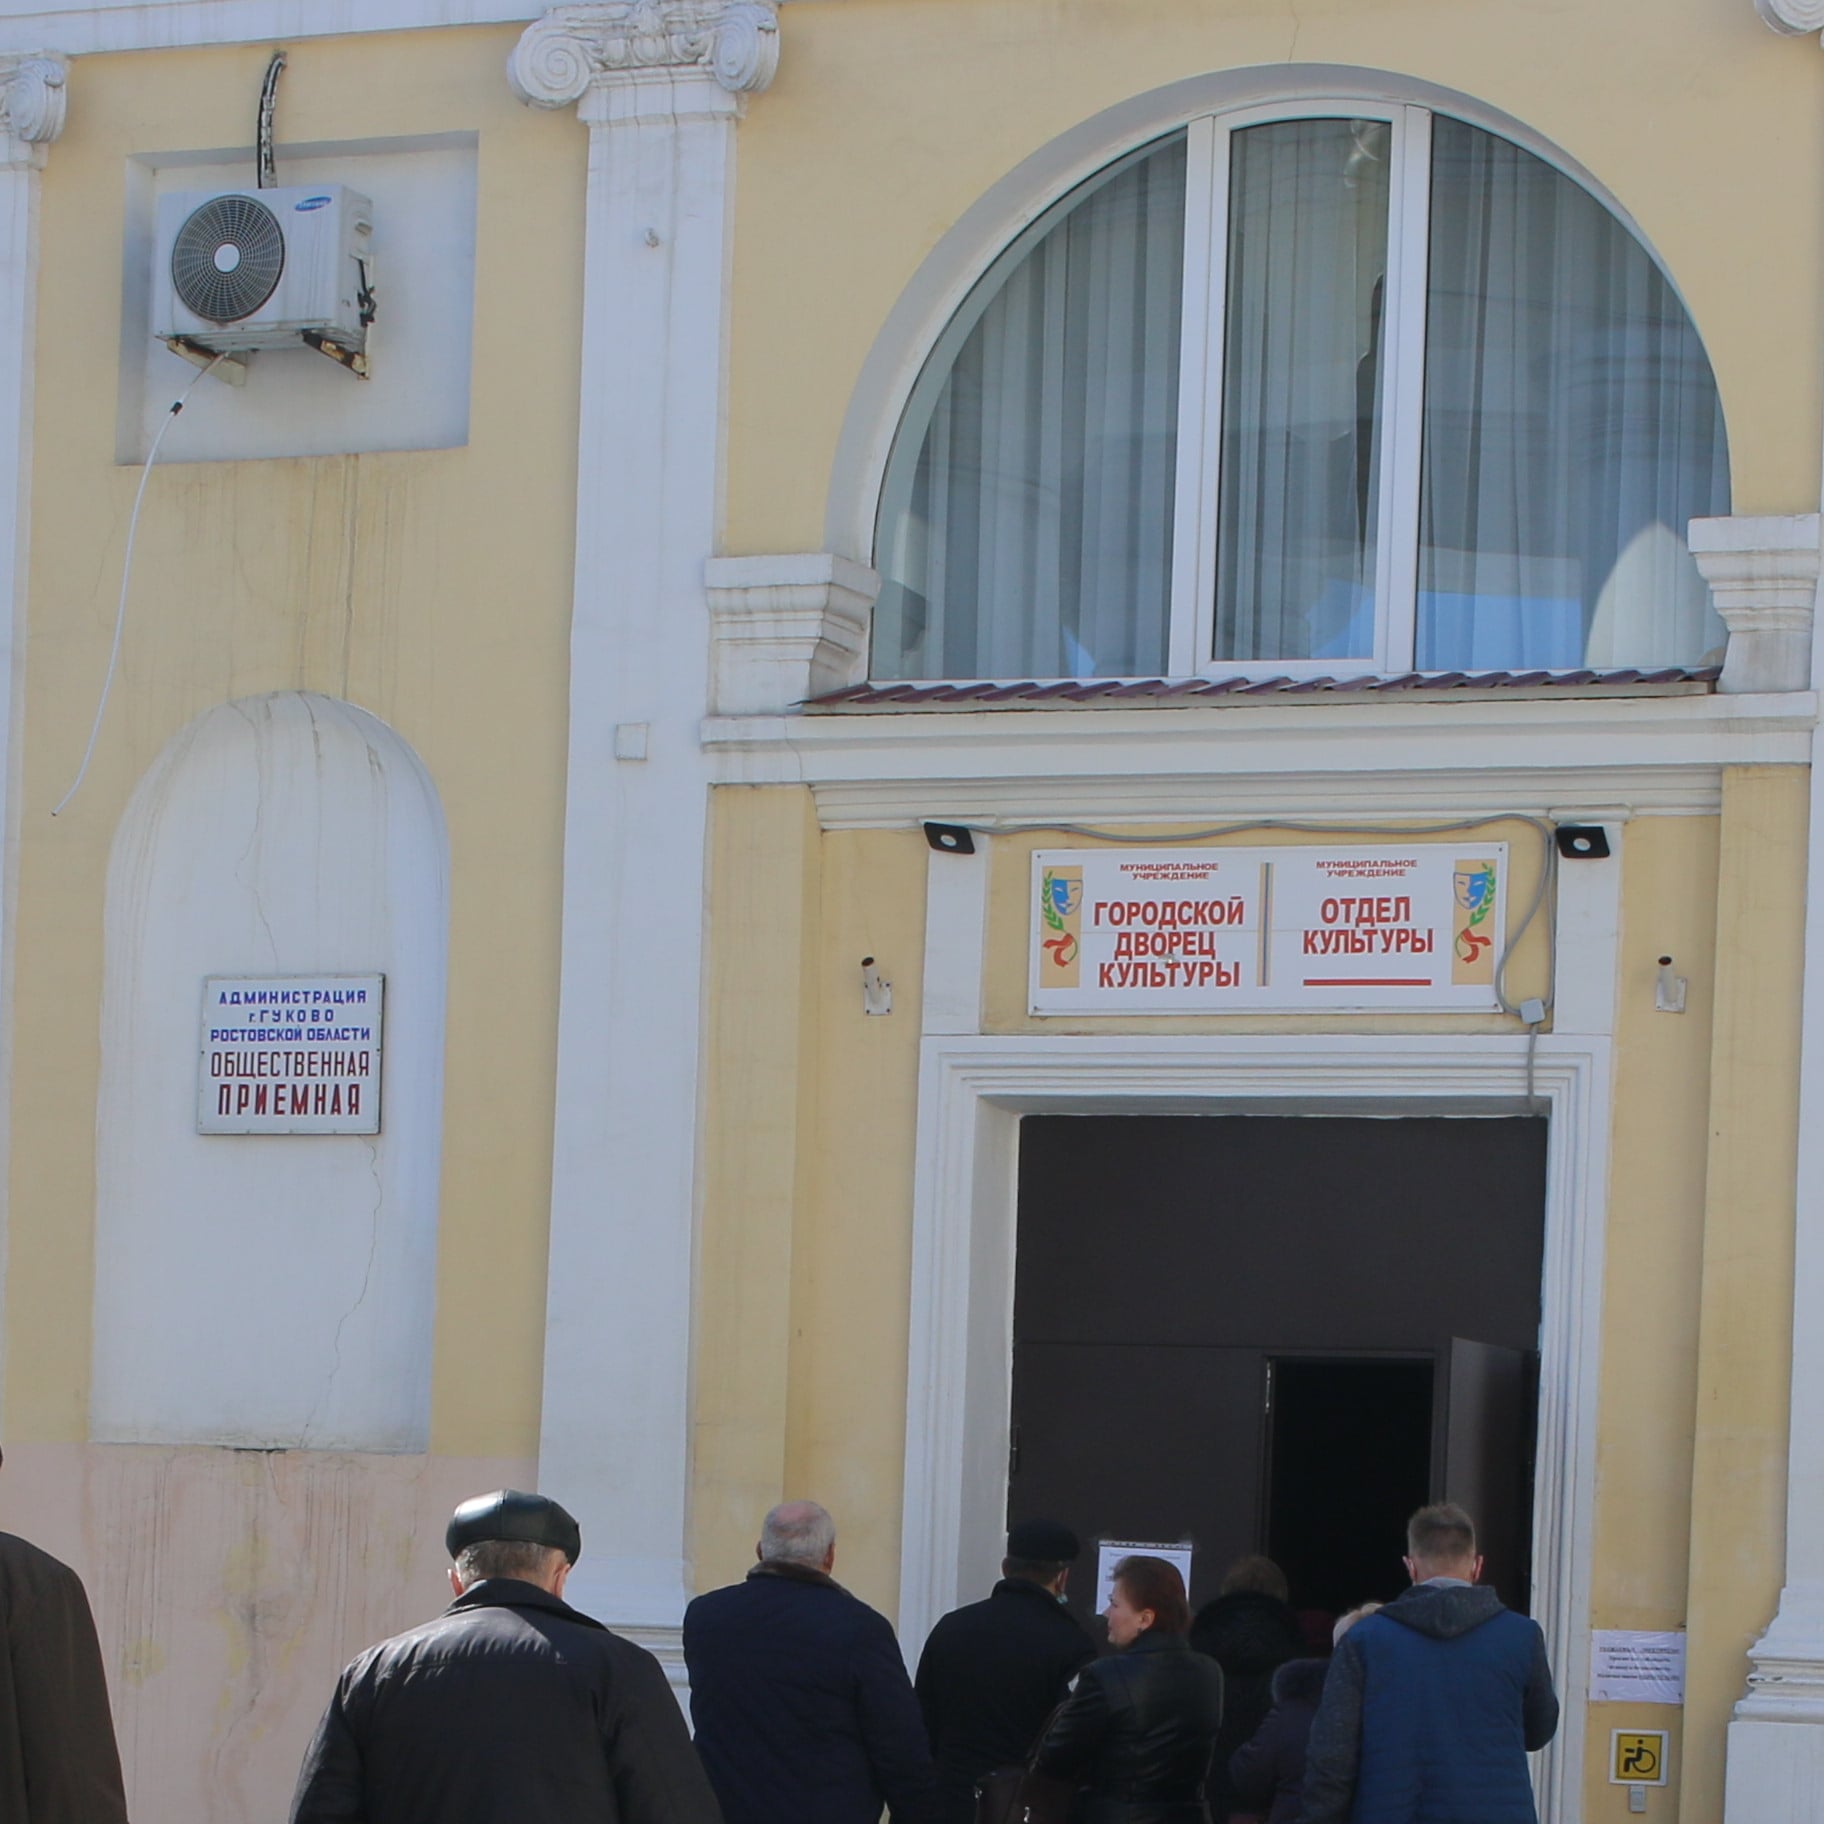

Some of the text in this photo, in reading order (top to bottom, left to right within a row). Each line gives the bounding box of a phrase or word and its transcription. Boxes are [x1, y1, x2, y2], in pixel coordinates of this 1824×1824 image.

[1093, 896, 1245, 930] ГОРОДСКОЙ
[1320, 896, 1411, 927] ОТДЕЛ
[1114, 930, 1216, 961] ДВОРЕЦ
[1303, 928, 1434, 955] КУЛЬТУРЫ
[1098, 961, 1240, 988] КУЛЬТУРЫ
[219, 990, 367, 1005] АДМИНИСТРАЦИЯ
[210, 1027, 370, 1042] РОСТОВСКОЙ ОБЛАСТИ
[211, 1051, 370, 1079] ОБЩЕСТВЕННАЯ
[218, 1084, 361, 1116] ПРИЕМНАЯ
